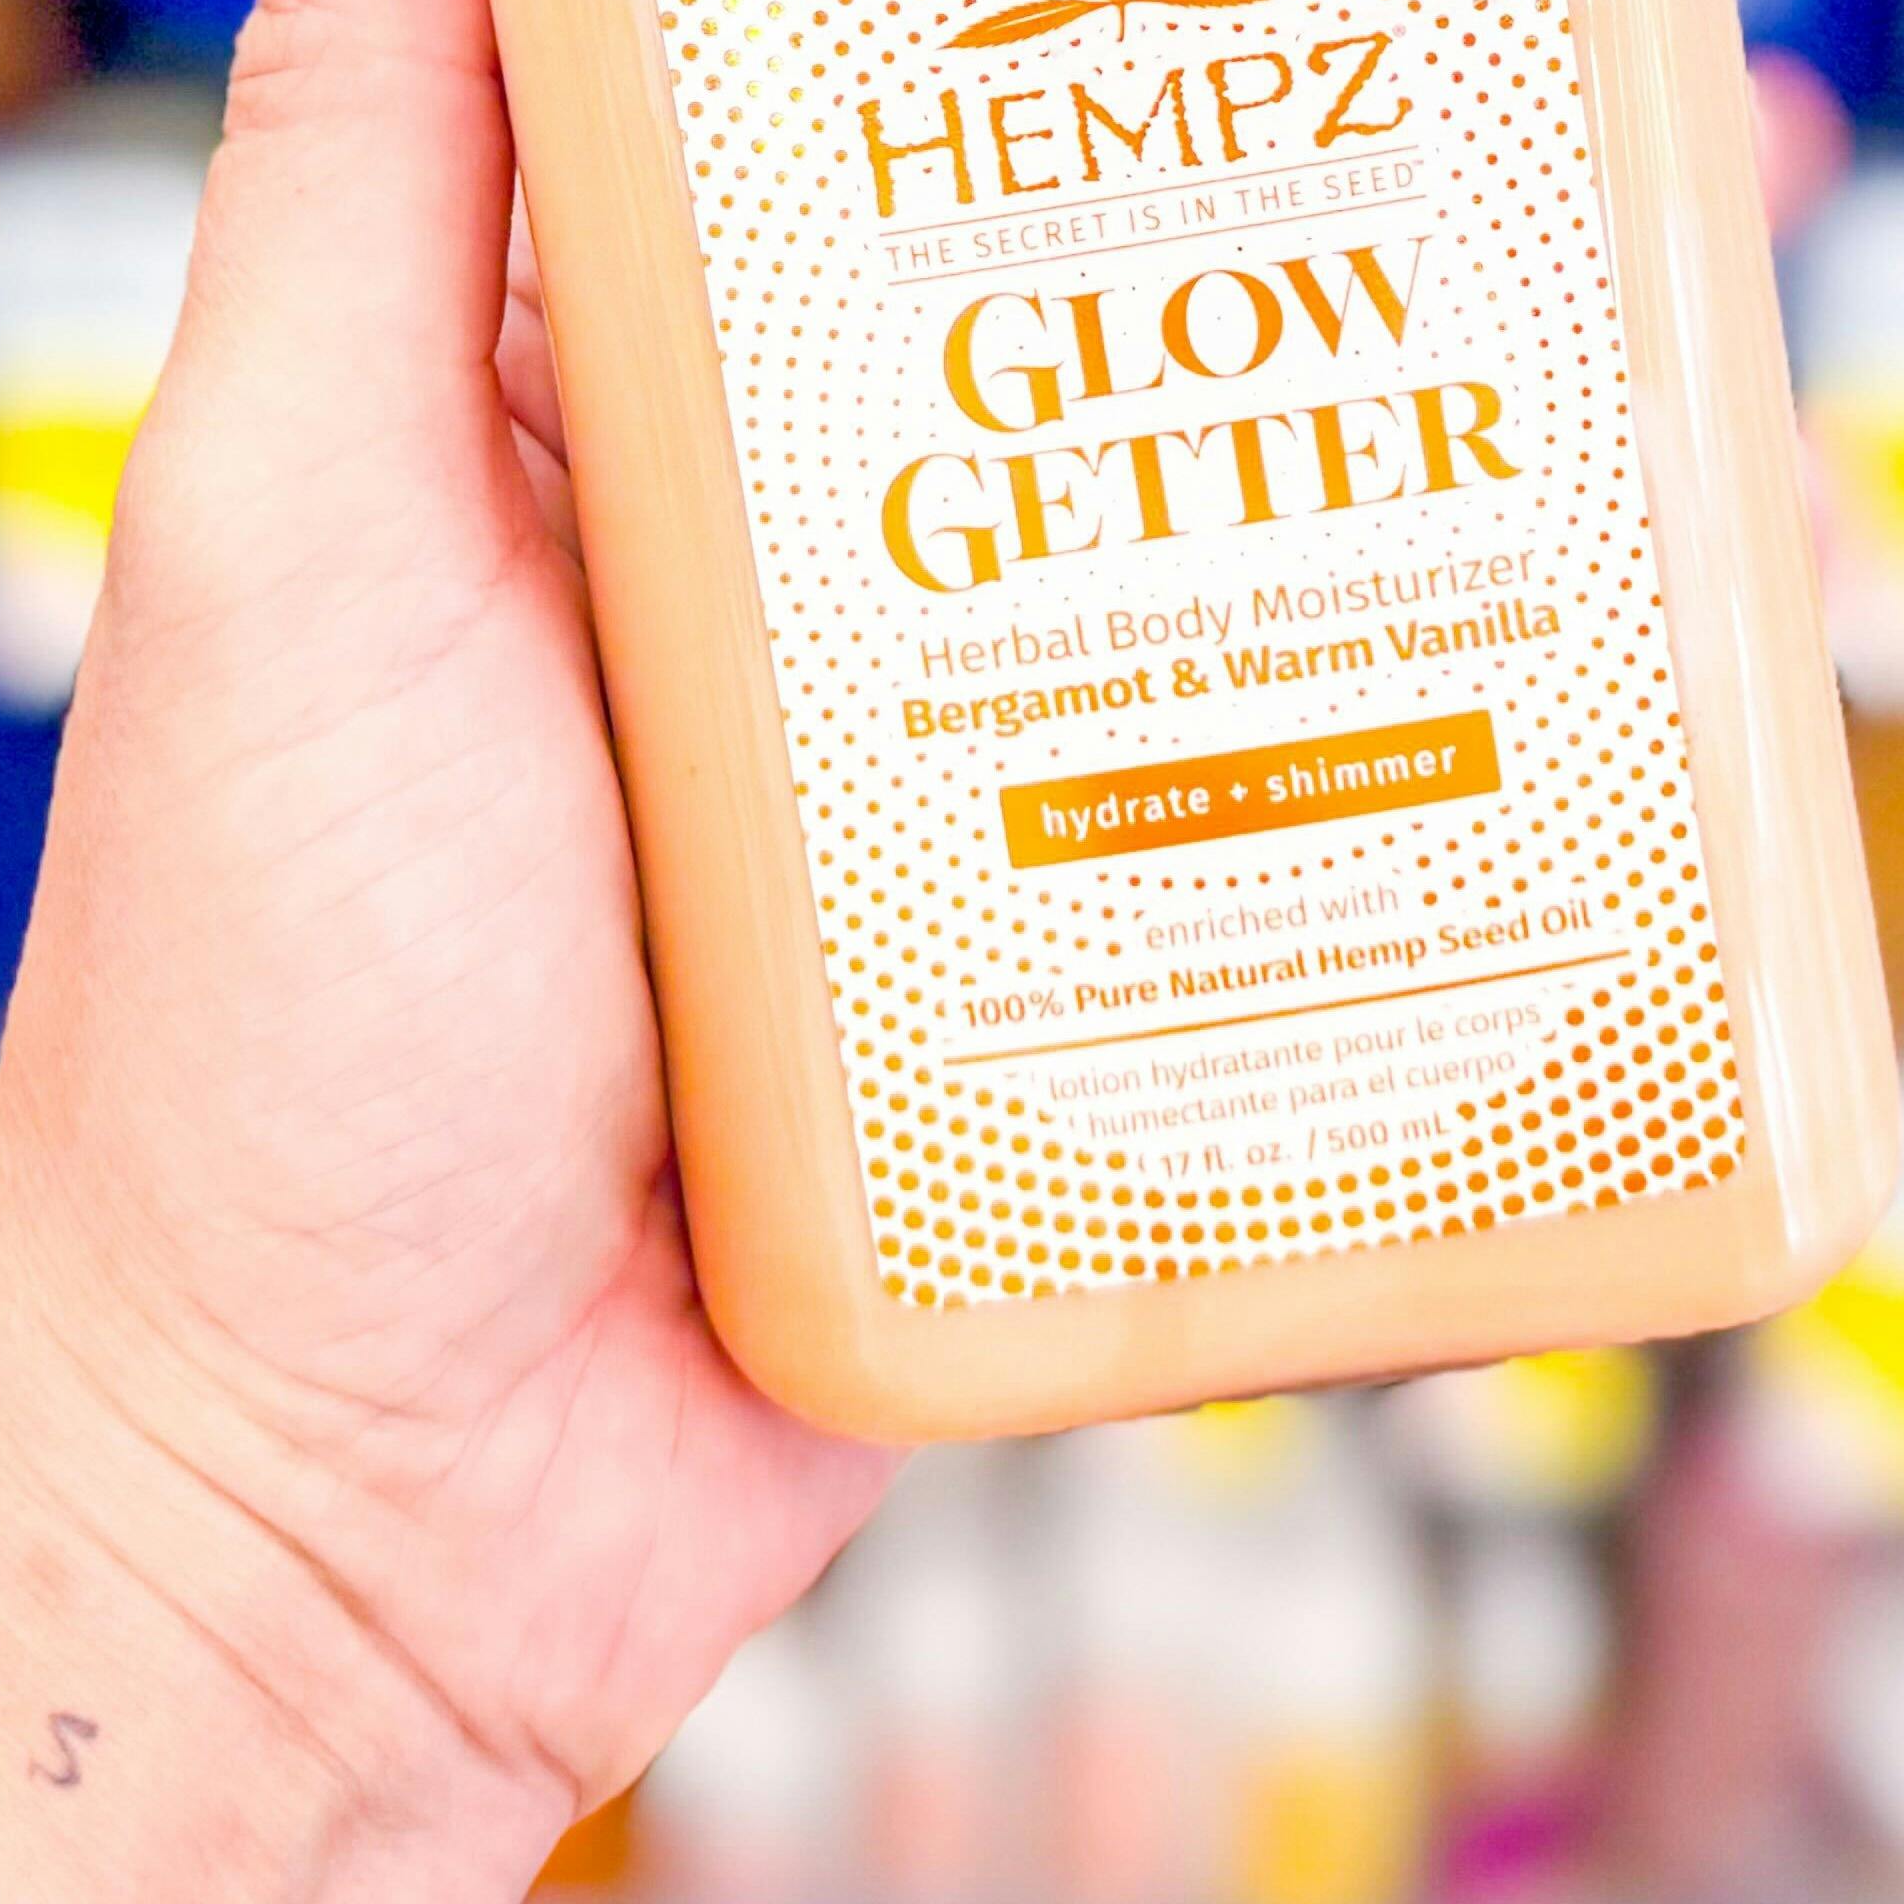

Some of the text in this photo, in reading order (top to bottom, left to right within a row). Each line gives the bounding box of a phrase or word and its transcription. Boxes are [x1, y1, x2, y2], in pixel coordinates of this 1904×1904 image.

[857, 32, 1413, 215] HEMPZ
[886, 240, 955, 272] THE
[976, 214, 1106, 259] SECRET
[1128, 206, 1160, 232] IS
[1183, 196, 1216, 225] IN
[1235, 180, 1305, 216] THE
[943, 236, 1432, 433] GLOW
[882, 381, 1522, 592] GETTER
[903, 598, 1561, 739] Bergamot & Warm Vanilla
[920, 549, 1535, 679] Herbal Body Moisturizer
[1041, 784, 1212, 840] hydrate
[1265, 743, 1458, 804] shimmer
[961, 899, 1593, 1029] 100% Pure Natural Hemp Seed Oil
[1146, 883, 1400, 951] enriched with
[1049, 1003, 1542, 1101] lotion hydratante pour le corps
[1088, 1050, 1516, 1138] humectante para el cuerpo
[1160, 1151, 1190, 1179] 17
[1204, 1143, 1234, 1172] fl.
[1247, 1141, 1292, 1166] oz.
[1328, 1119, 1389, 1153] 500
[1401, 1109, 1451, 1142] mL
